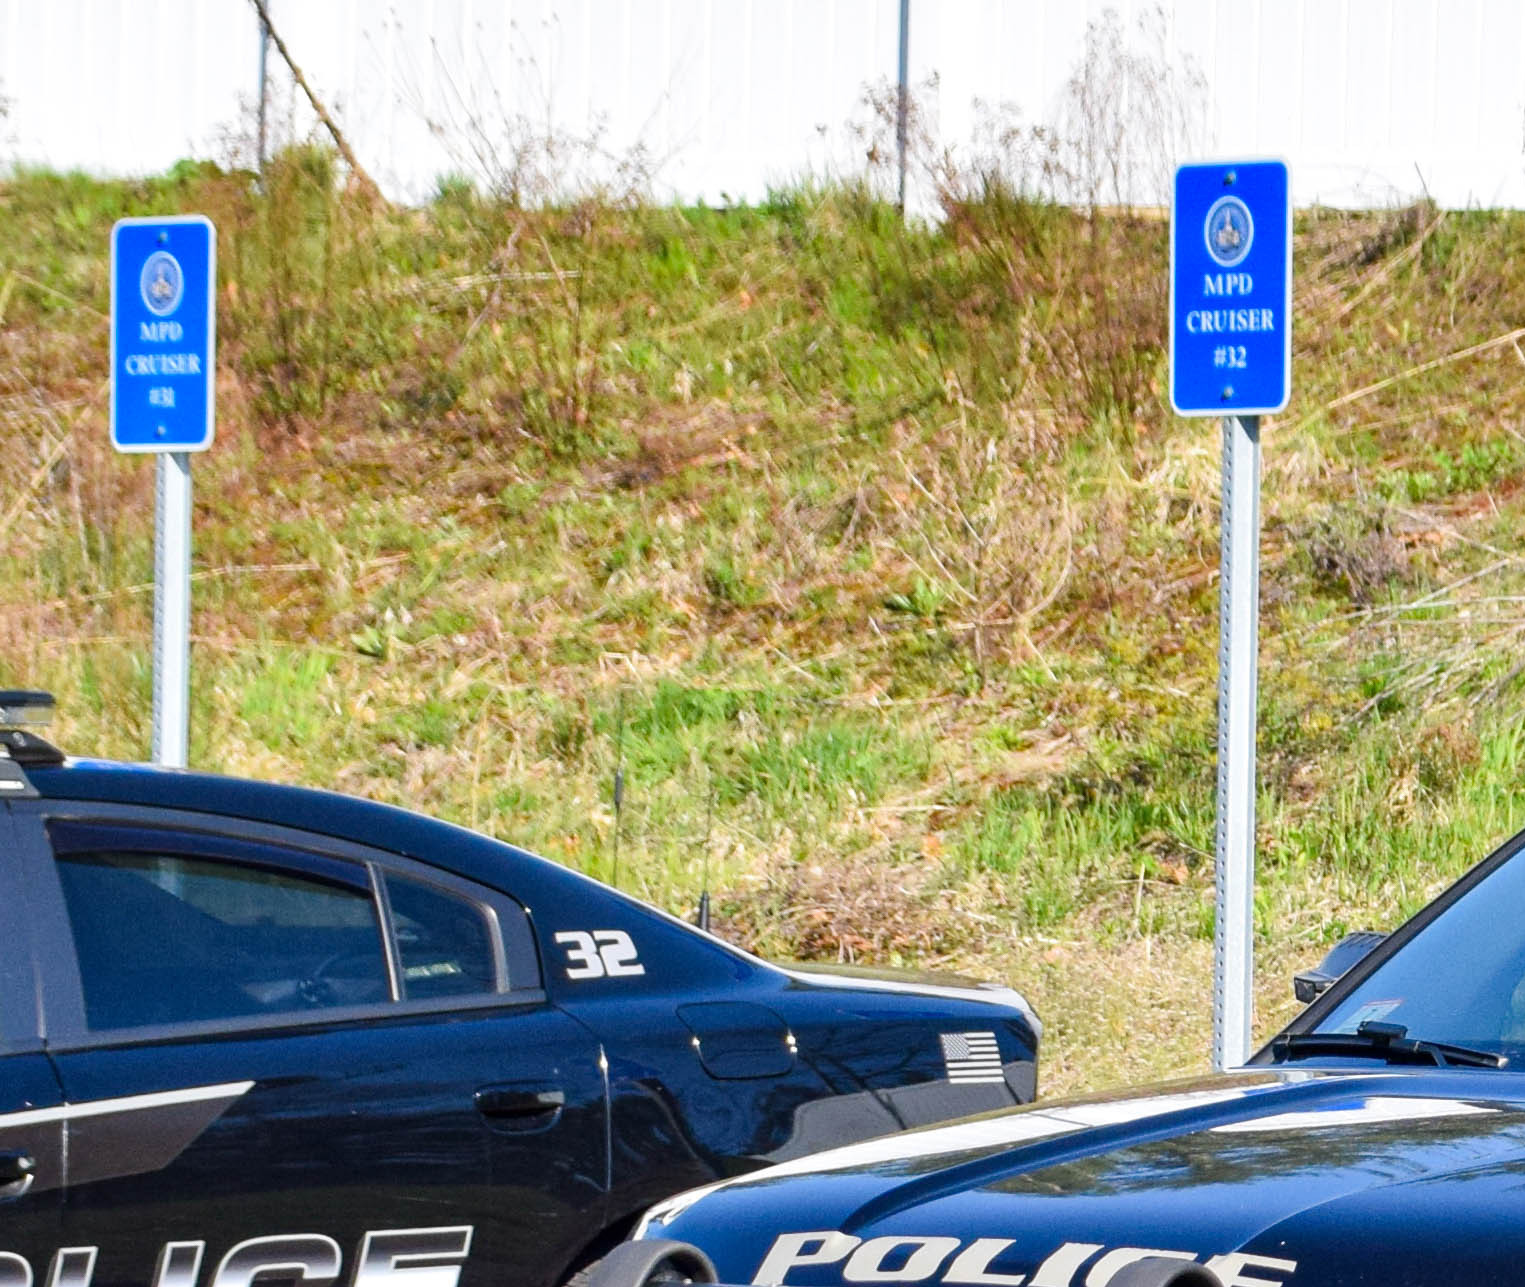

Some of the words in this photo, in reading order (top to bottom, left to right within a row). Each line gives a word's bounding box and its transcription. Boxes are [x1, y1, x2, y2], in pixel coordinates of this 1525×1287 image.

[1203, 273, 1253, 296] MPD
[140, 321, 183, 342] MPD
[1186, 309, 1274, 334] CRUISER
[125, 353, 201, 375] CRUISER
[1213, 345, 1247, 369] #32
[555, 930, 645, 979] 32
